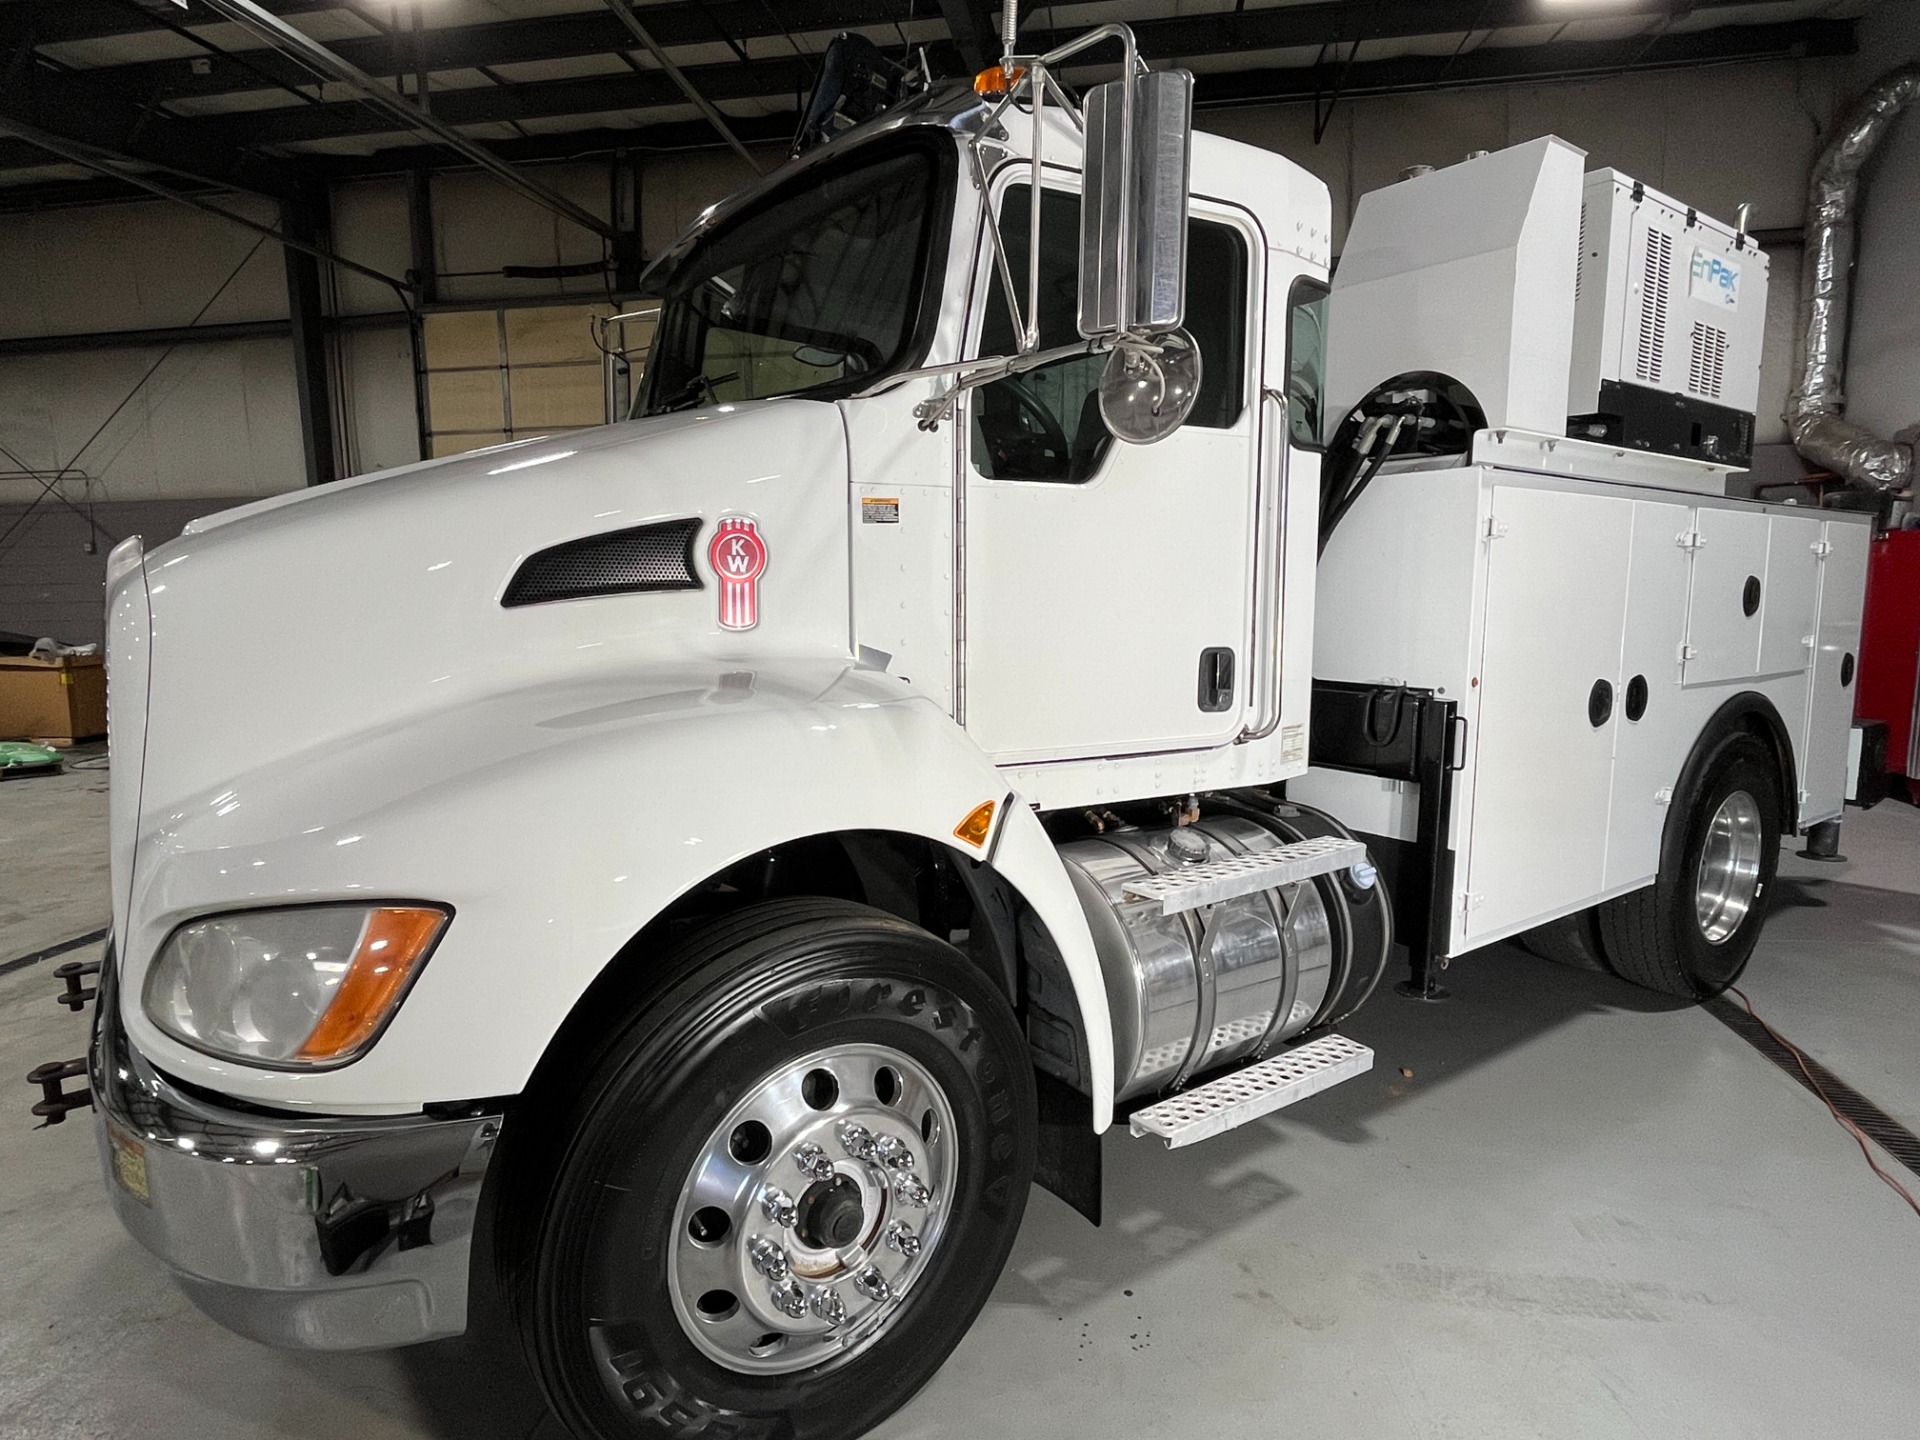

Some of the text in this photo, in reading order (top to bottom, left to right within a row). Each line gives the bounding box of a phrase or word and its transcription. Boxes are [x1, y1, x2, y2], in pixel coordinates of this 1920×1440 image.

[1692, 252, 1738, 291] EnPak
[731, 538, 746, 556] K
[726, 555, 750, 573] W
